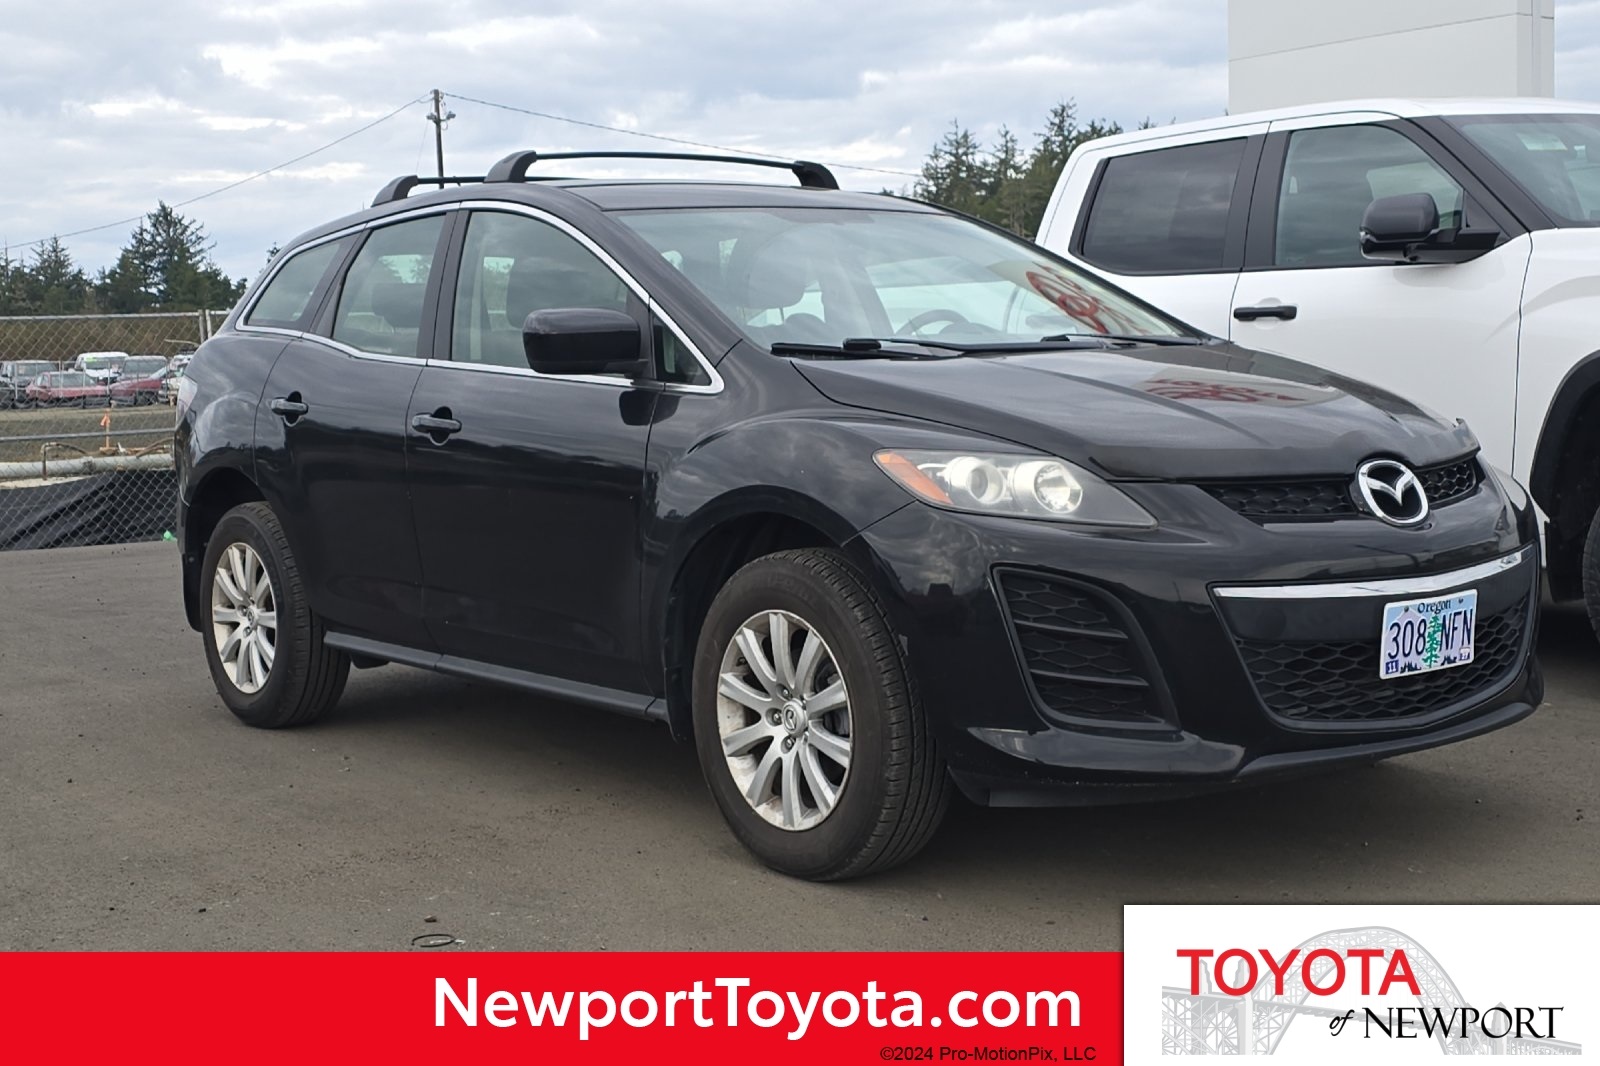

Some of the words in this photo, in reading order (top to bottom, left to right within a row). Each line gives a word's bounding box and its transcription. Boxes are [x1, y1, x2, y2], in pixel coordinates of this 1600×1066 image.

[1417, 600, 1452, 614] Oregon
[1387, 618, 1427, 660] 308
[1439, 608, 1473, 652] NFN
